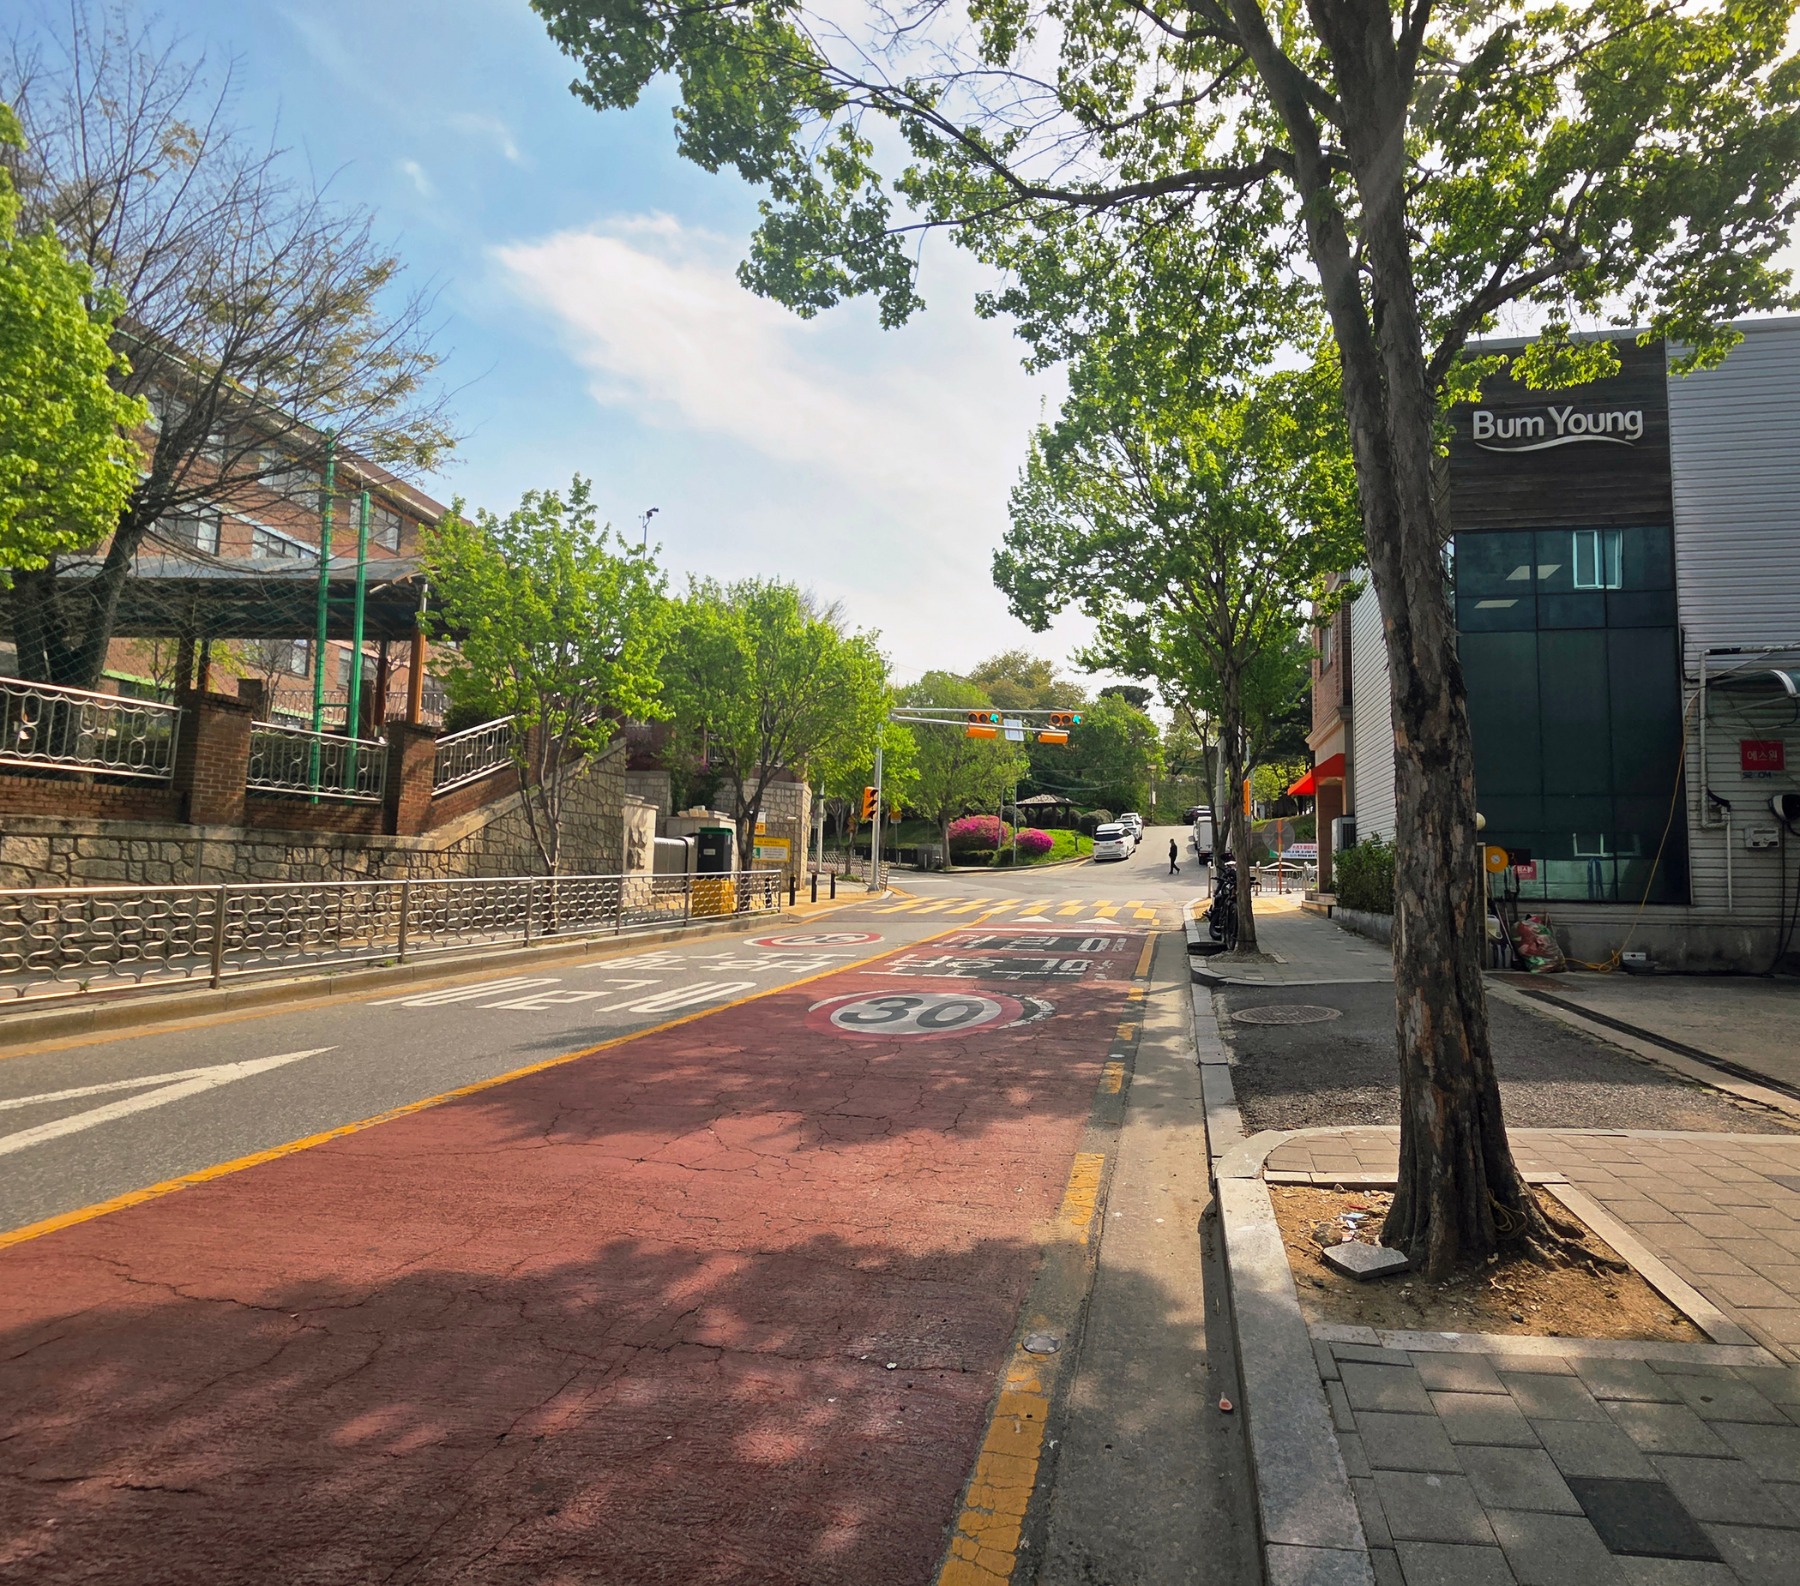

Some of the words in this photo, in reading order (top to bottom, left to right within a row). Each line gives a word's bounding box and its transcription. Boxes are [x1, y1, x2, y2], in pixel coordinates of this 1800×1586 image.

[1473, 410, 1545, 440] Bum
[1547, 405, 1643, 440] Young
[782, 934, 868, 944] 30
[576, 951, 857, 973] 보호구역
[366, 977, 757, 1013] 어린이
[840, 997, 984, 1029] 30
